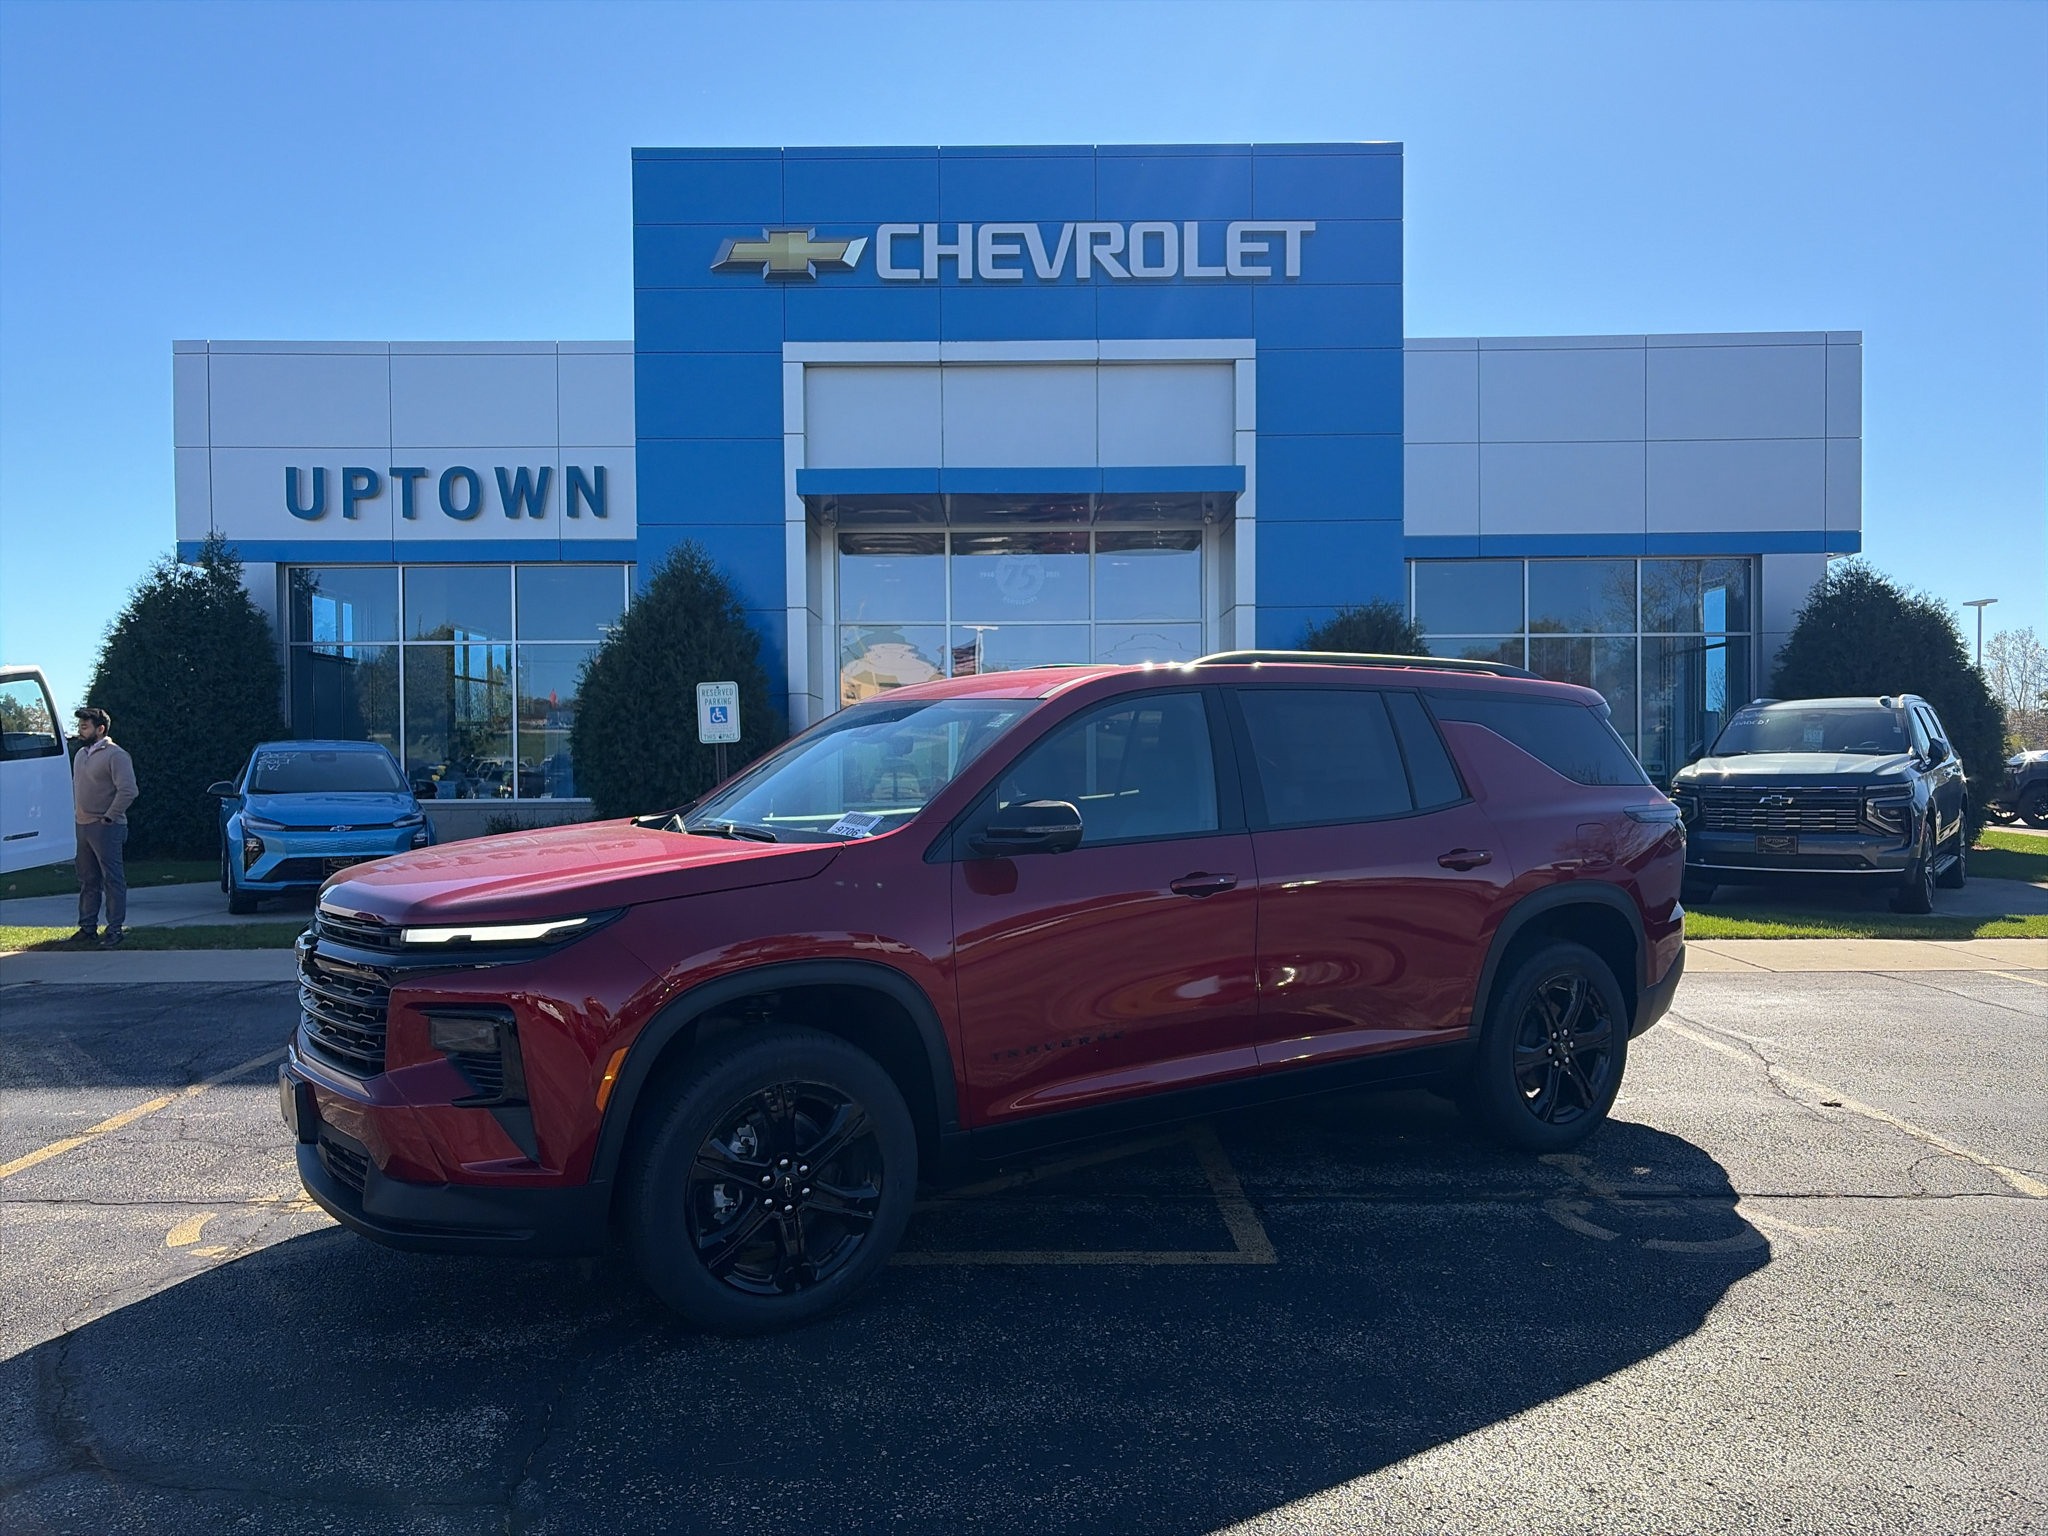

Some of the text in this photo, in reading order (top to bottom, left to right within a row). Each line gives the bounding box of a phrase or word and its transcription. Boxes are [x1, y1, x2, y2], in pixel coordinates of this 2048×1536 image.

[876, 221, 1316, 280] CHEVROLET
[285, 466, 608, 521] UPTOWN
[1003, 564, 1037, 590] 75
[701, 688, 734, 697] RESERVED
[705, 697, 732, 706] PARKING
[834, 825, 861, 837] 9706
